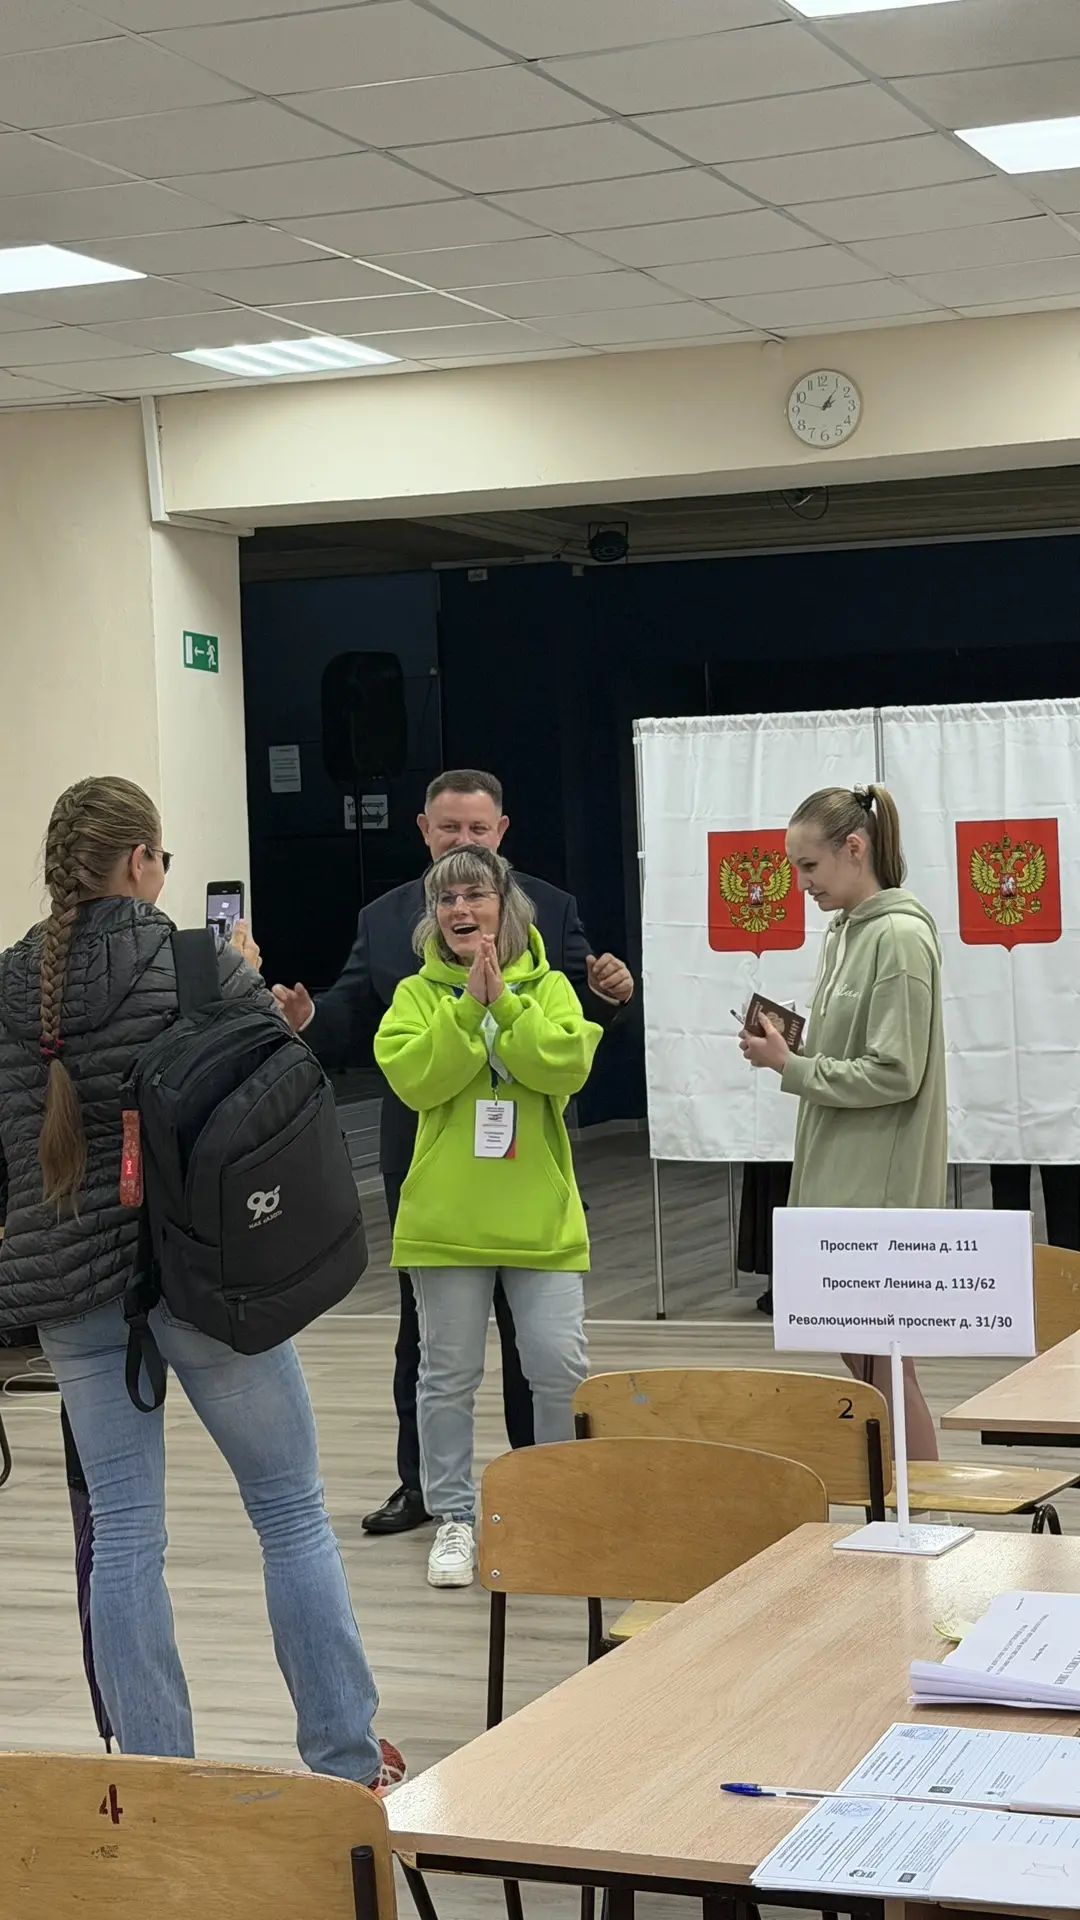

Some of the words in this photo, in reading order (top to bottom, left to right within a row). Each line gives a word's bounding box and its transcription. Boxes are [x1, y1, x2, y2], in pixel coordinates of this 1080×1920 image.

[807, 379, 813, 391] 11
[817, 375, 828, 387] 12
[796, 391, 806, 404] 10
[843, 386, 851, 398] 2
[792, 405, 800, 417] 9
[847, 400, 856, 412] 3
[797, 419, 806, 431] 8
[843, 415, 851, 425] 4
[808, 427, 816, 439] 7
[820, 430, 830, 441] 6
[834, 424, 843, 436] 5
[820, 1240, 879, 1253] Проспект
[888, 1240, 936, 1251] Ленина
[939, 1241, 952, 1254] д.
[956, 1240, 978, 1251] 111
[822, 1277, 881, 1290] Проспект
[883, 1277, 932, 1289] Ленина
[935, 1279, 948, 1291] д.
[952, 1278, 996, 1290] 113/62
[789, 1314, 895, 1327] Революционный
[898, 1317, 956, 1329] проспект
[959, 1318, 972, 1329] д.
[975, 1316, 1013, 1329] 31/30
[838, 1397, 854, 1419] 2
[99, 1784, 123, 1824] 4
